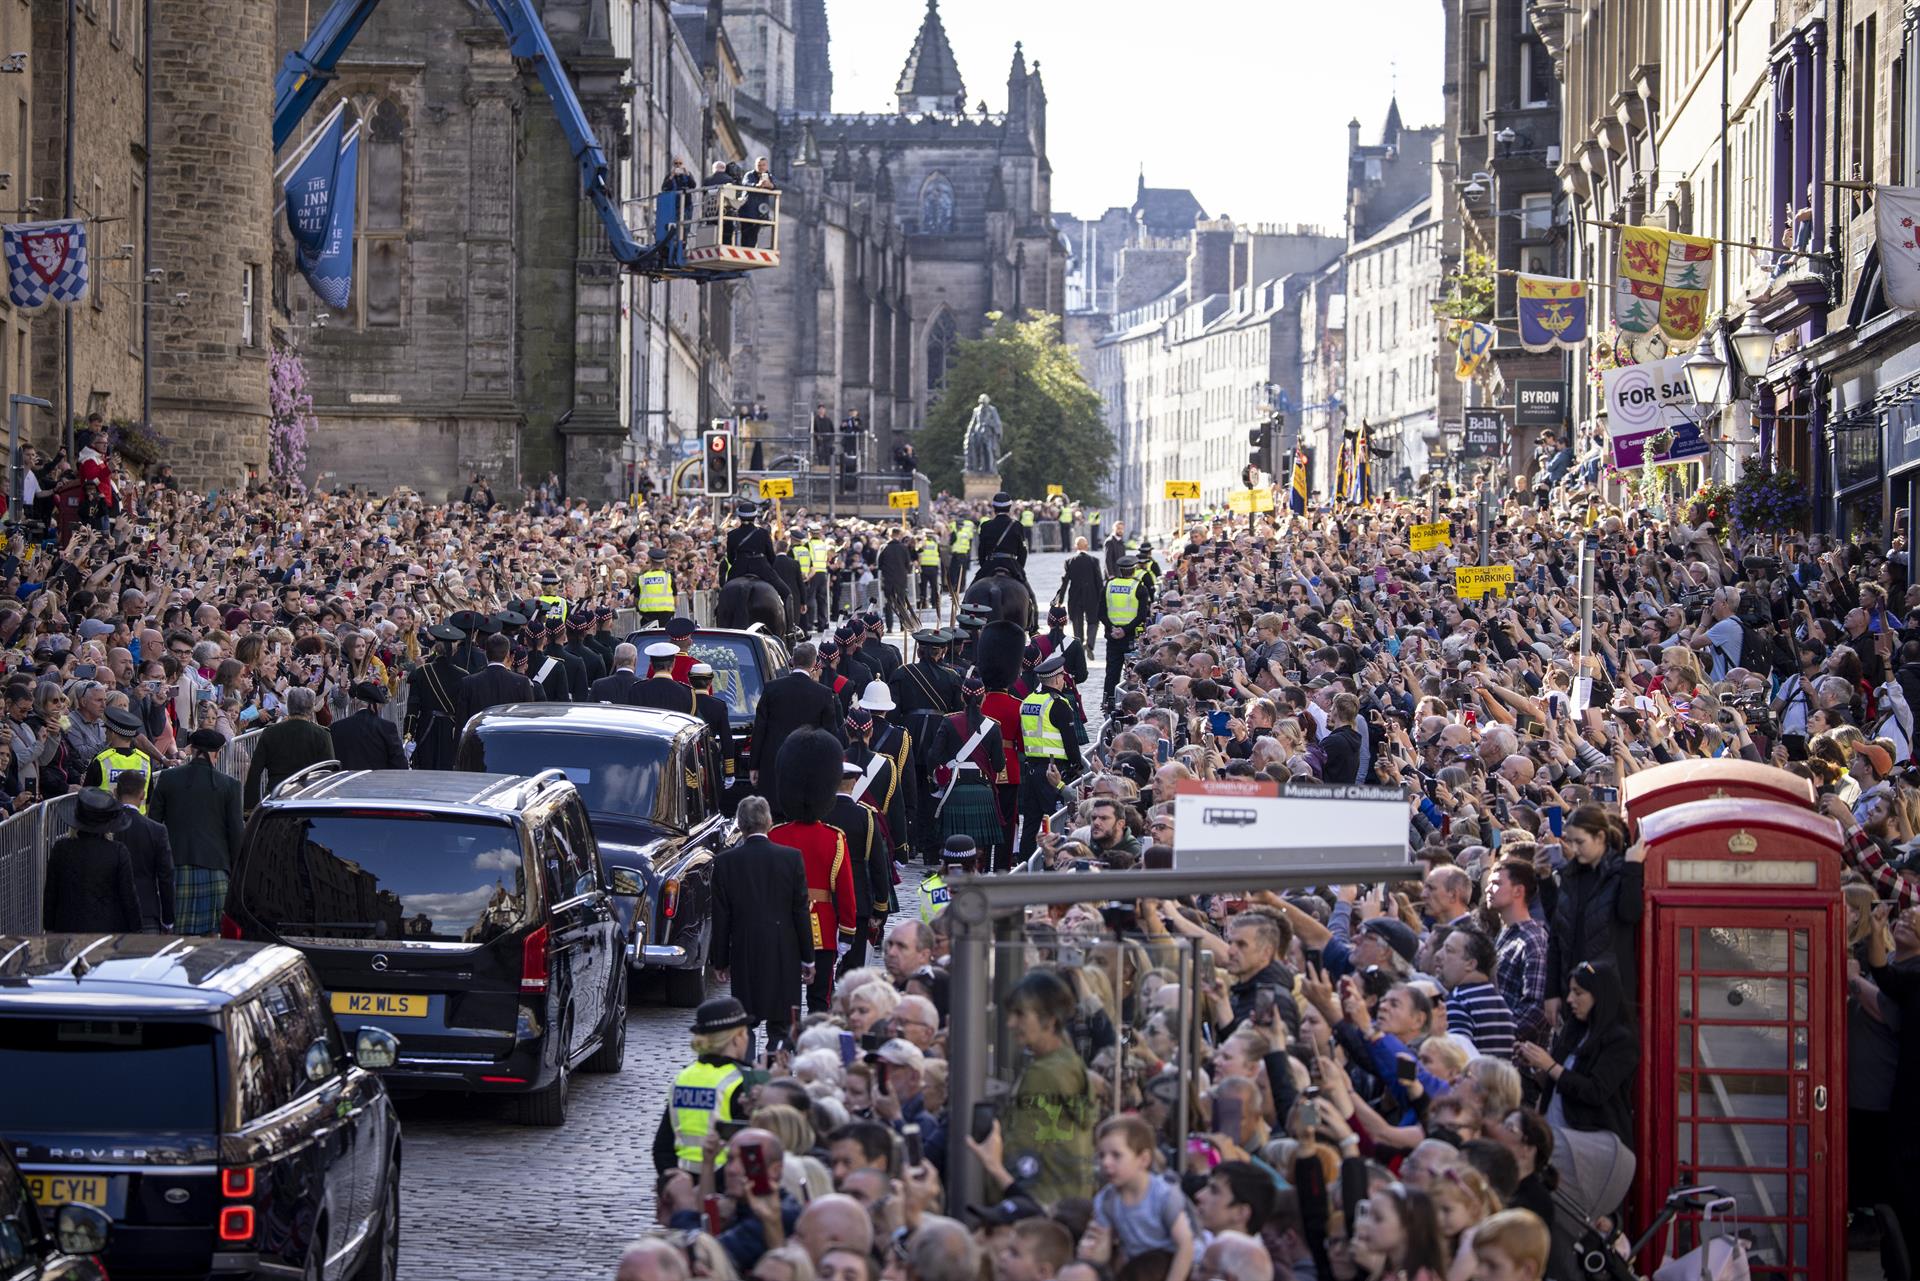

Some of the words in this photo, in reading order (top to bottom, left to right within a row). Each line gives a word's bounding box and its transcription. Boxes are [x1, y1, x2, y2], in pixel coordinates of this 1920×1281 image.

[308, 179, 325, 191] THE
[304, 191, 328, 206] INN
[298, 209, 311, 217] ON
[316, 206, 327, 216] TH
[299, 217, 322, 230] MIL
[1521, 391, 1559, 403] BYRON
[1618, 387, 1657, 407] FOR
[1661, 380, 1691, 399] SAL
[1468, 417, 1497, 430] Bella
[1468, 431, 1497, 443] Italia
[1424, 527, 1450, 537] PARKING
[1458, 575, 1471, 584] NO
[1474, 573, 1512, 583] PARKING
[1284, 785, 1332, 798] Museum
[1333, 786, 1347, 798] of
[1347, 787, 1404, 800] Childhood
[932, 888, 952, 903] POL
[349, 995, 371, 1011] M2
[376, 997, 409, 1012] WLS
[675, 1088, 714, 1108] POLICE
[50, 1147, 148, 1159] ROVER
[52, 1179, 96, 1201] CYH
